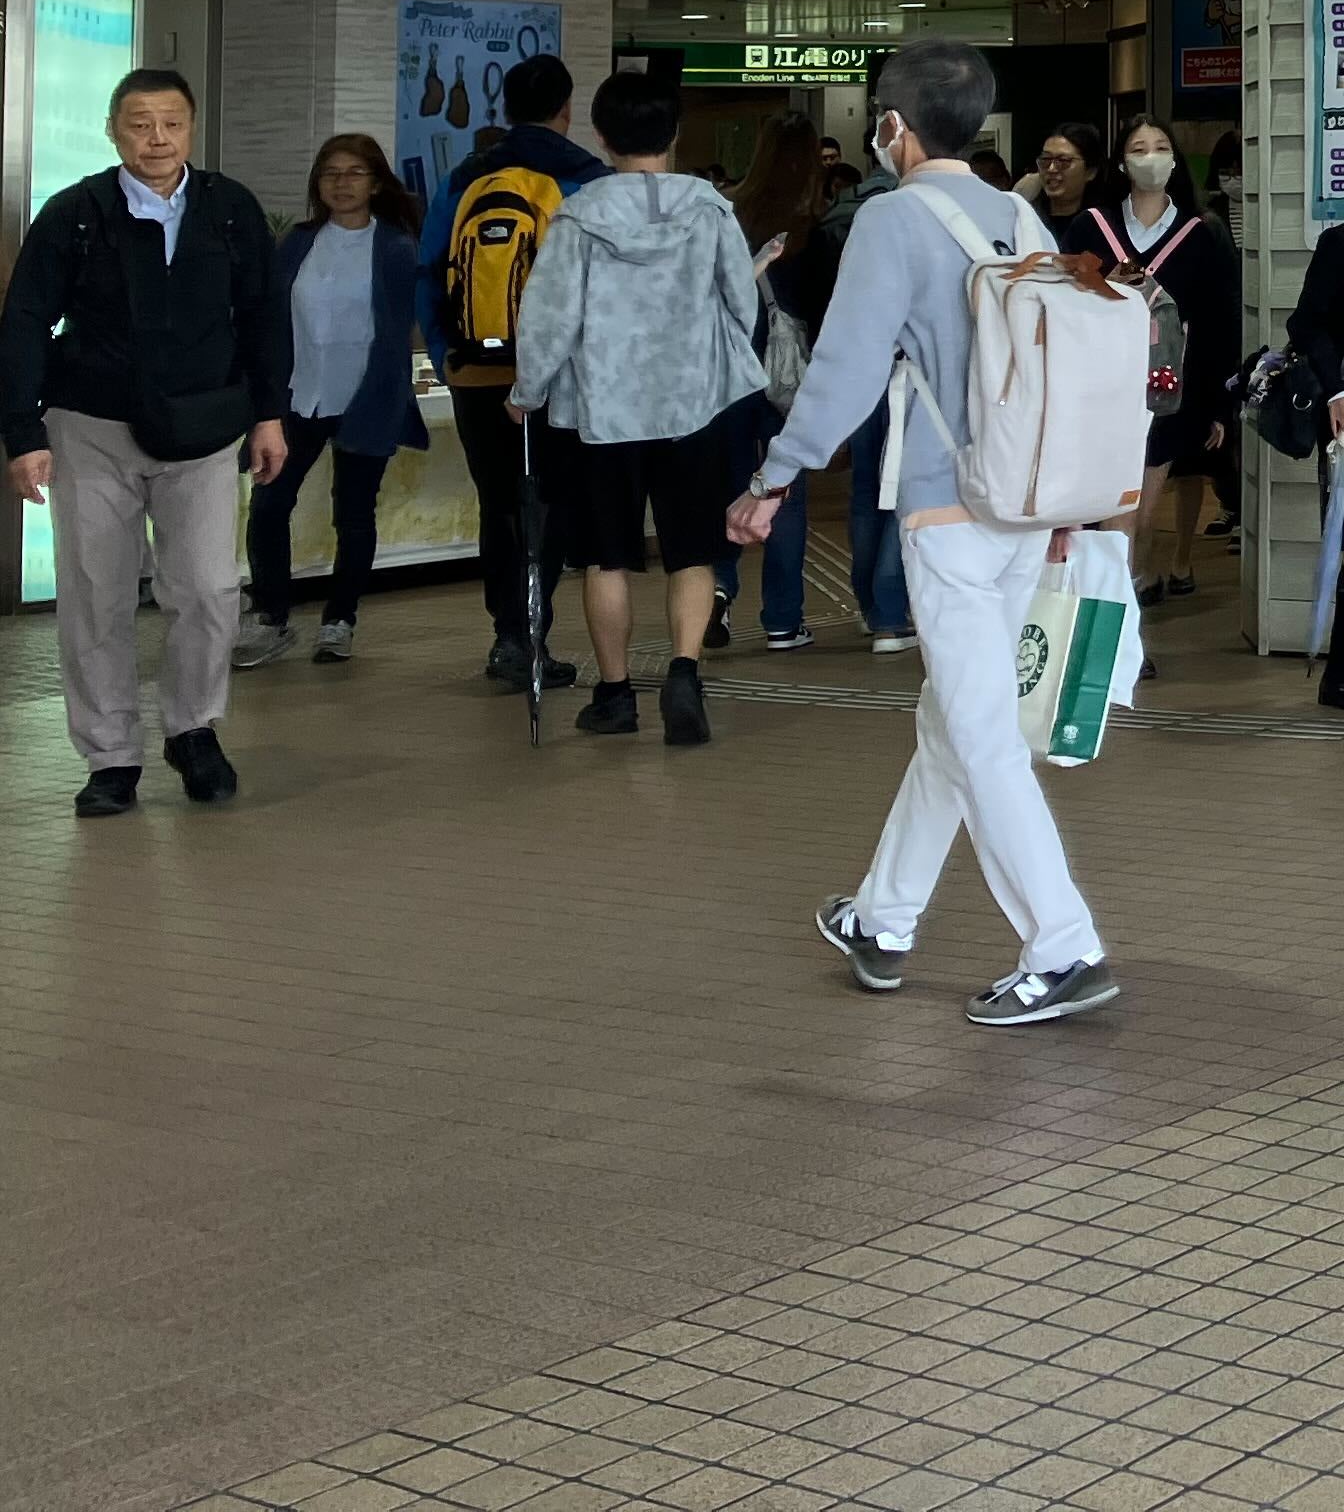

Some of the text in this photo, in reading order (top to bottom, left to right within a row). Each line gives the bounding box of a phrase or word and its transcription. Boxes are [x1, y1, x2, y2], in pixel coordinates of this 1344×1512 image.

[419, 18, 515, 43] Peter Rabbit
[777, 74, 795, 82] Line
